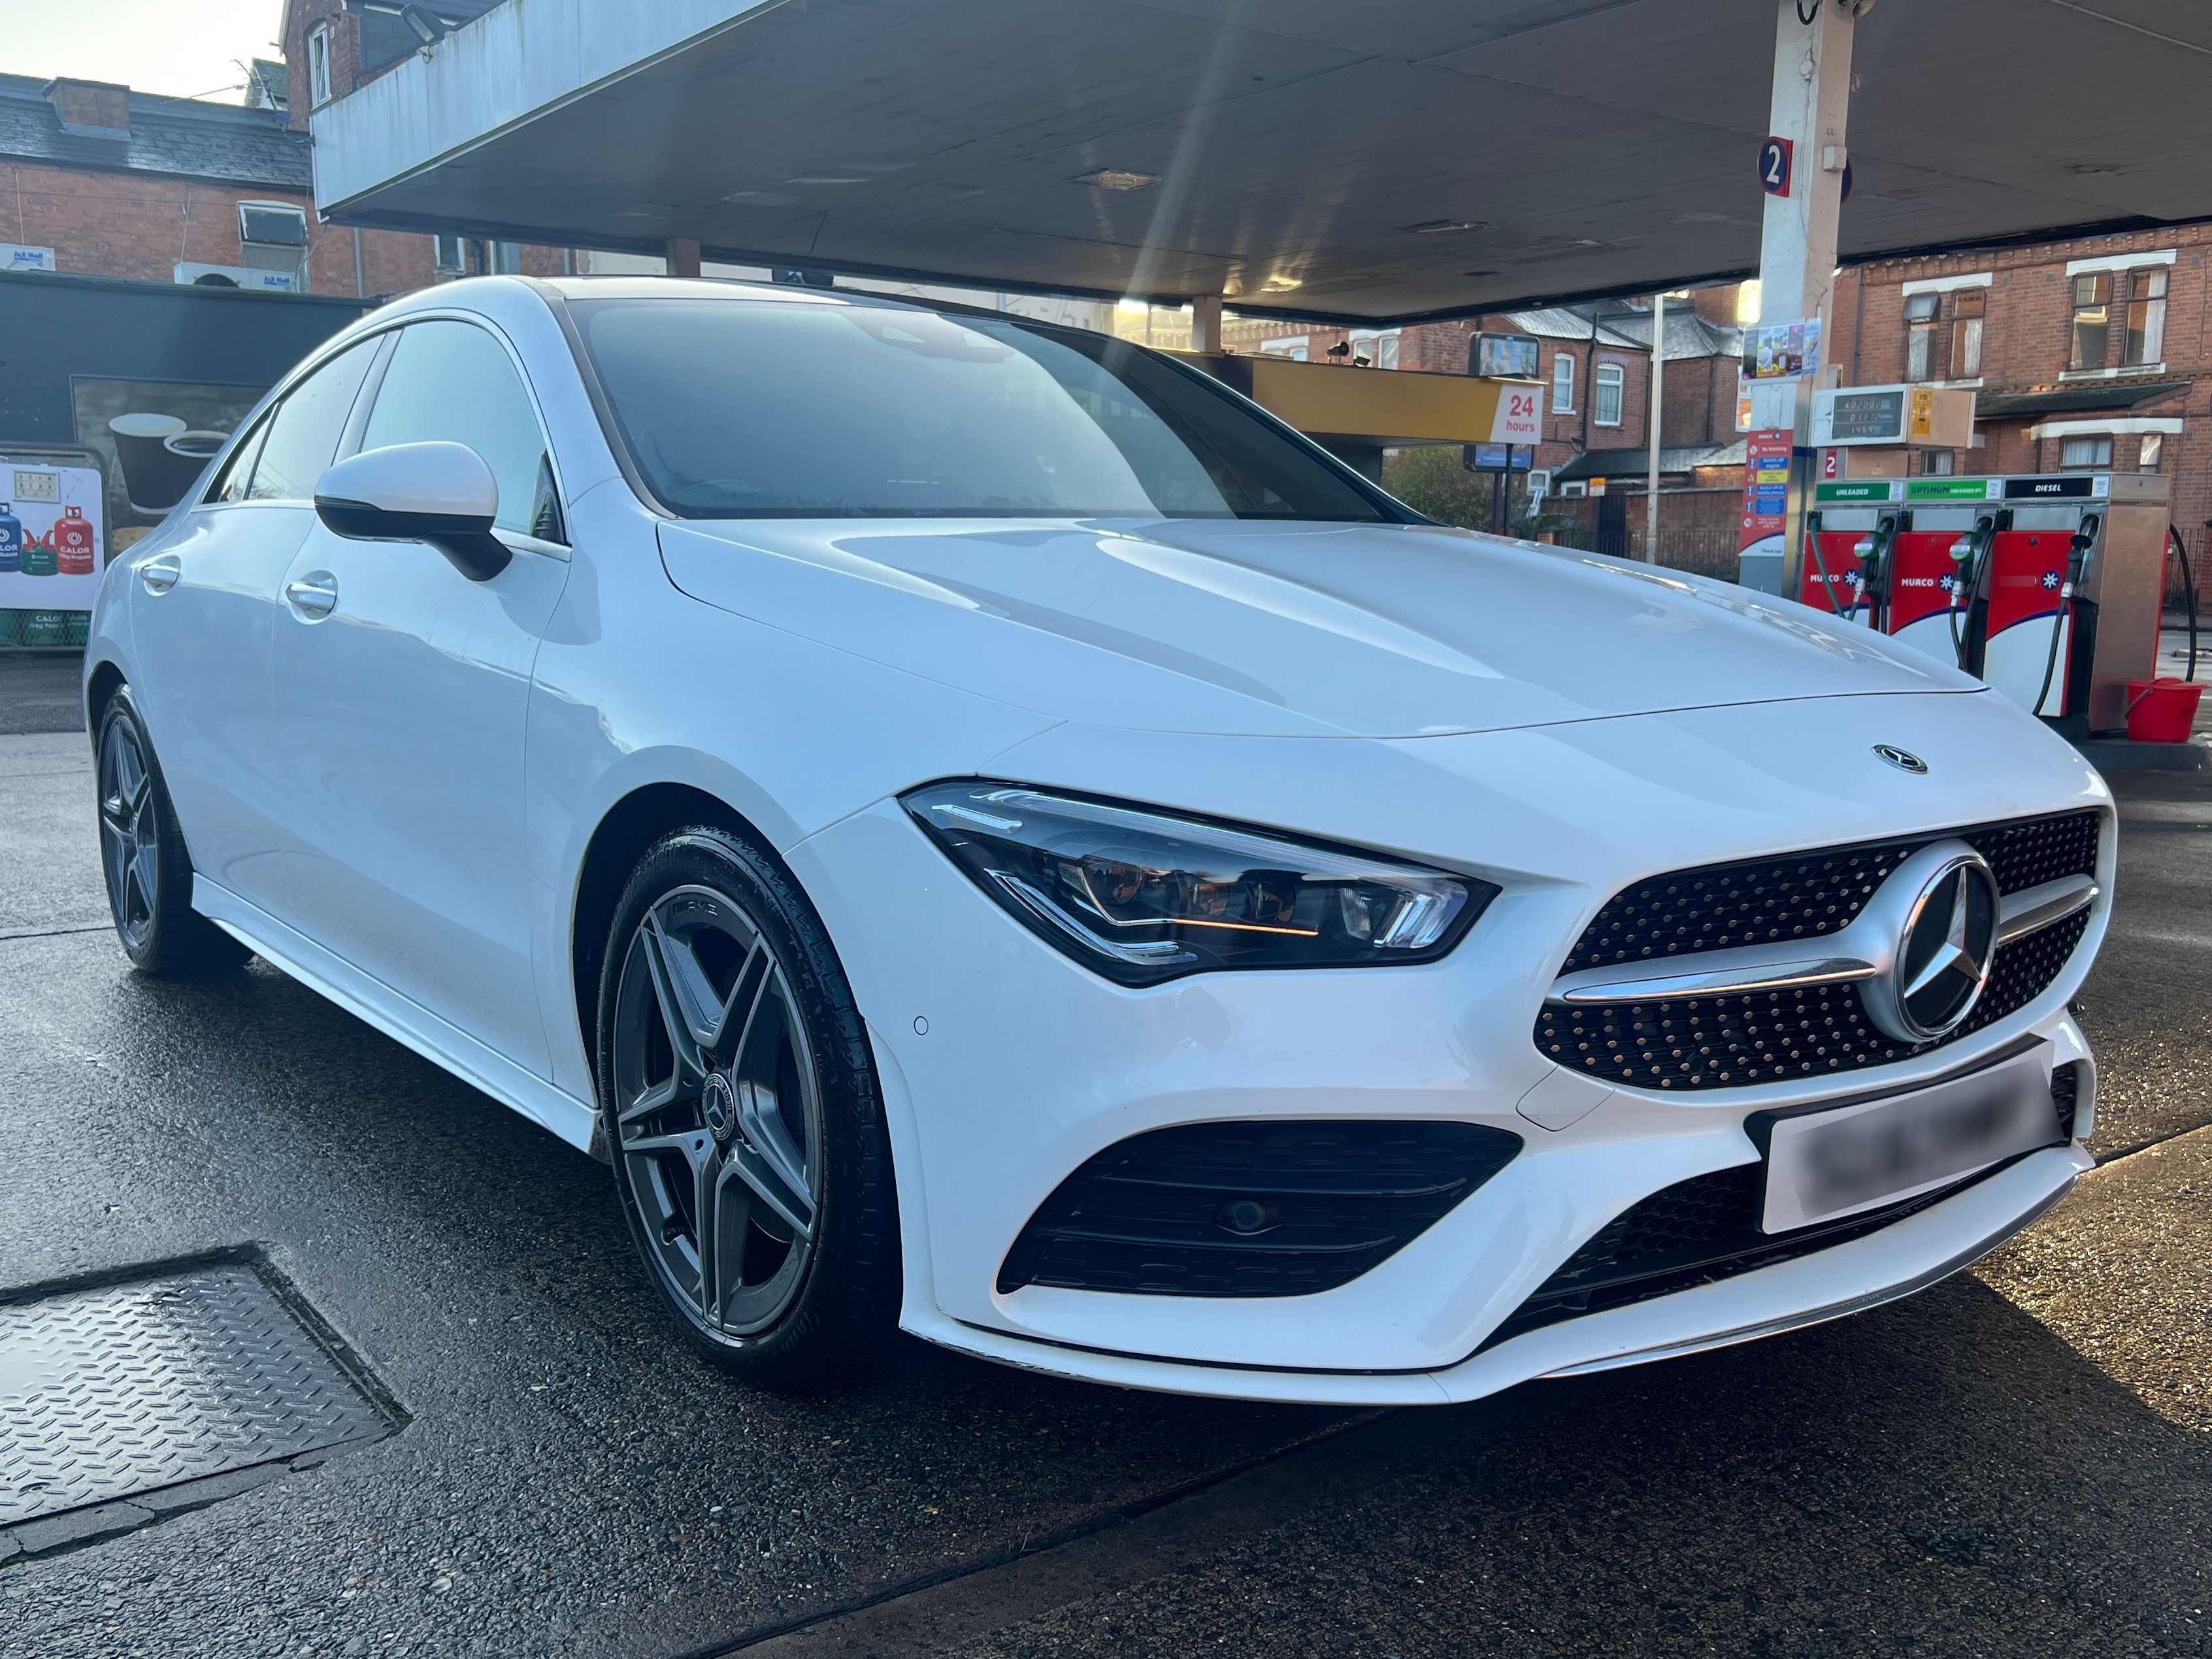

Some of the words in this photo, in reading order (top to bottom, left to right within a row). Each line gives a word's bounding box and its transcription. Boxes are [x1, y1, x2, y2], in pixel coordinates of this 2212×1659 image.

[1766, 145, 1780, 184] 2
[1510, 395, 1534, 417] 24
[1506, 419, 1535, 432] hours
[1826, 456, 1835, 473] 2
[2035, 484, 2062, 493] DIESEL
[59, 546, 90, 554] CALOR
[1810, 574, 1840, 583] MUCO
[1901, 578, 1934, 587] MURCO
